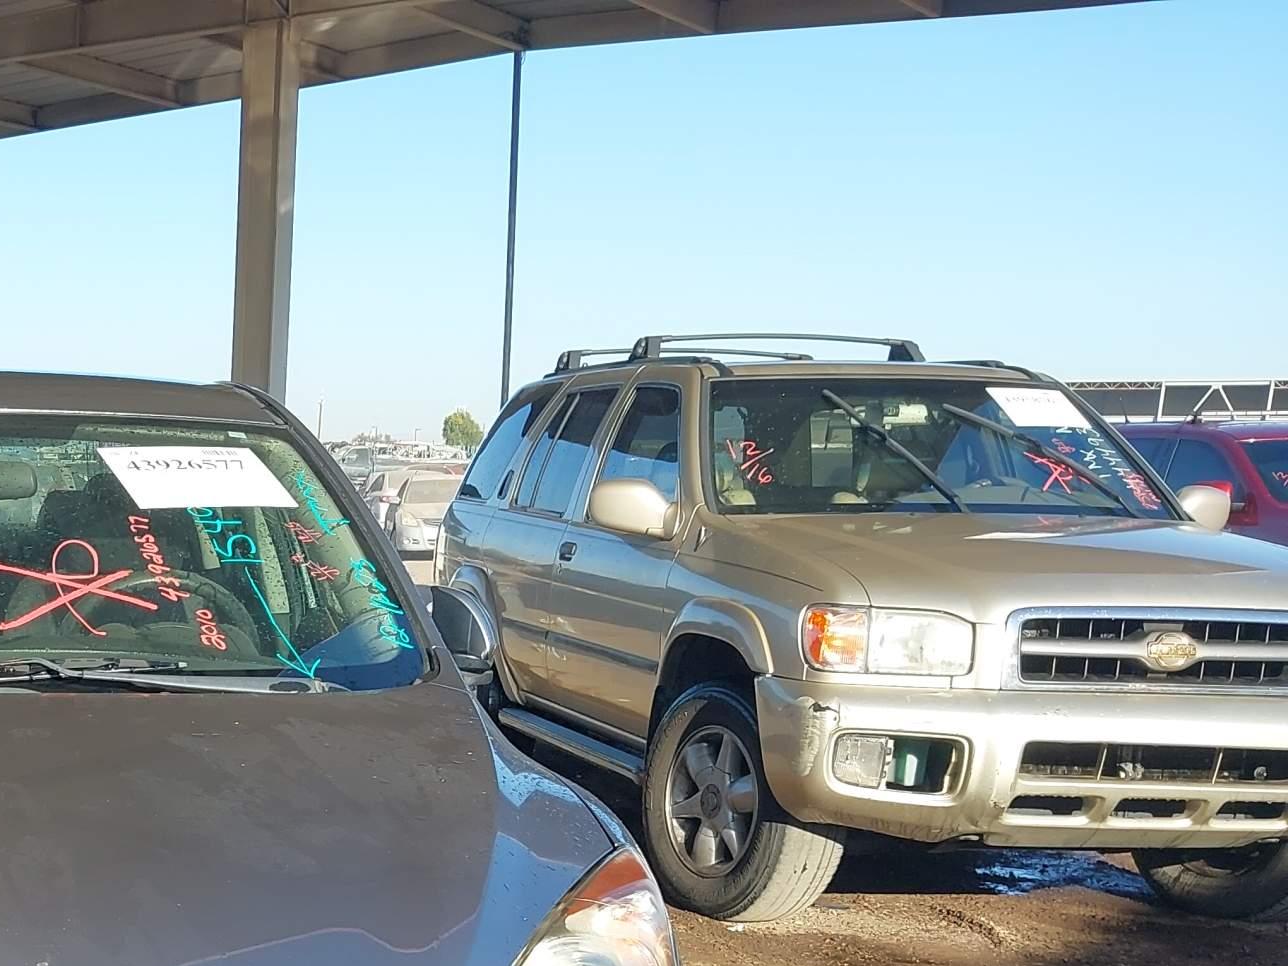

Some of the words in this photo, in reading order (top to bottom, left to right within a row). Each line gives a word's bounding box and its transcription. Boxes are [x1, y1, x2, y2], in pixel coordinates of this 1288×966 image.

[127, 459, 244, 472] 43926577
[128, 515, 191, 602] 43926577
[195, 609, 228, 650] 2010
